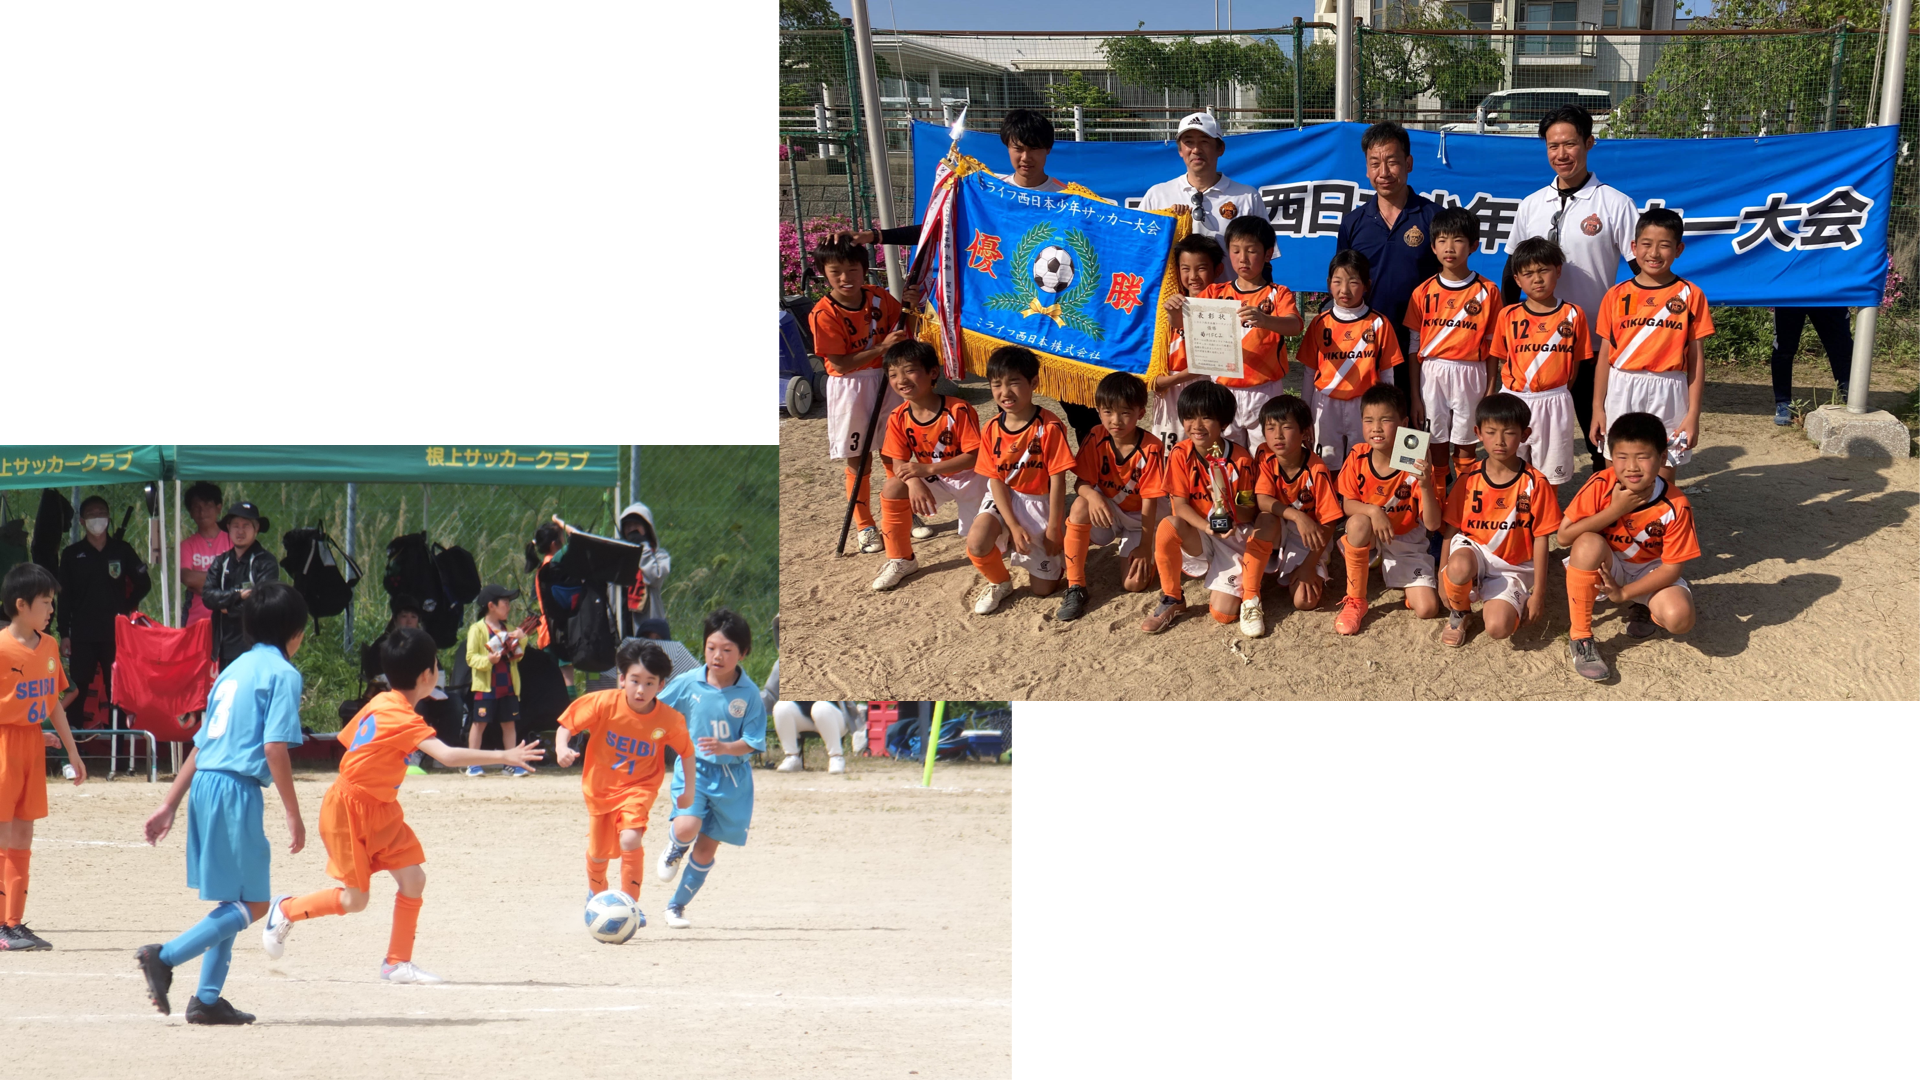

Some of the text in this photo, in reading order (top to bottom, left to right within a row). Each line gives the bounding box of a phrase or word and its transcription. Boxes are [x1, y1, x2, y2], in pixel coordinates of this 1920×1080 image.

[966, 228, 1145, 315] 優 勝
[1424, 293, 1440, 314] 11
[1621, 293, 1632, 316] 1
[843, 316, 858, 336] 3
[1511, 318, 1530, 340] 12
[1619, 317, 1684, 331] KIKUGAWA
[975, 317, 1101, 361] ミライフ西日本株式会社
[1322, 327, 1333, 347] 9
[849, 431, 861, 452] 3
[905, 427, 918, 448] 6
[993, 436, 1003, 459] 4
[1160, 431, 1178, 452] 13
[425, 446, 590, 471] 根上サッカークラブ
[1471, 489, 1483, 514] 5
[16, 677, 55, 700] SEIBI
[710, 720, 730, 739] 10
[606, 731, 656, 757] SEIBI
[611, 752, 636, 775] 71
